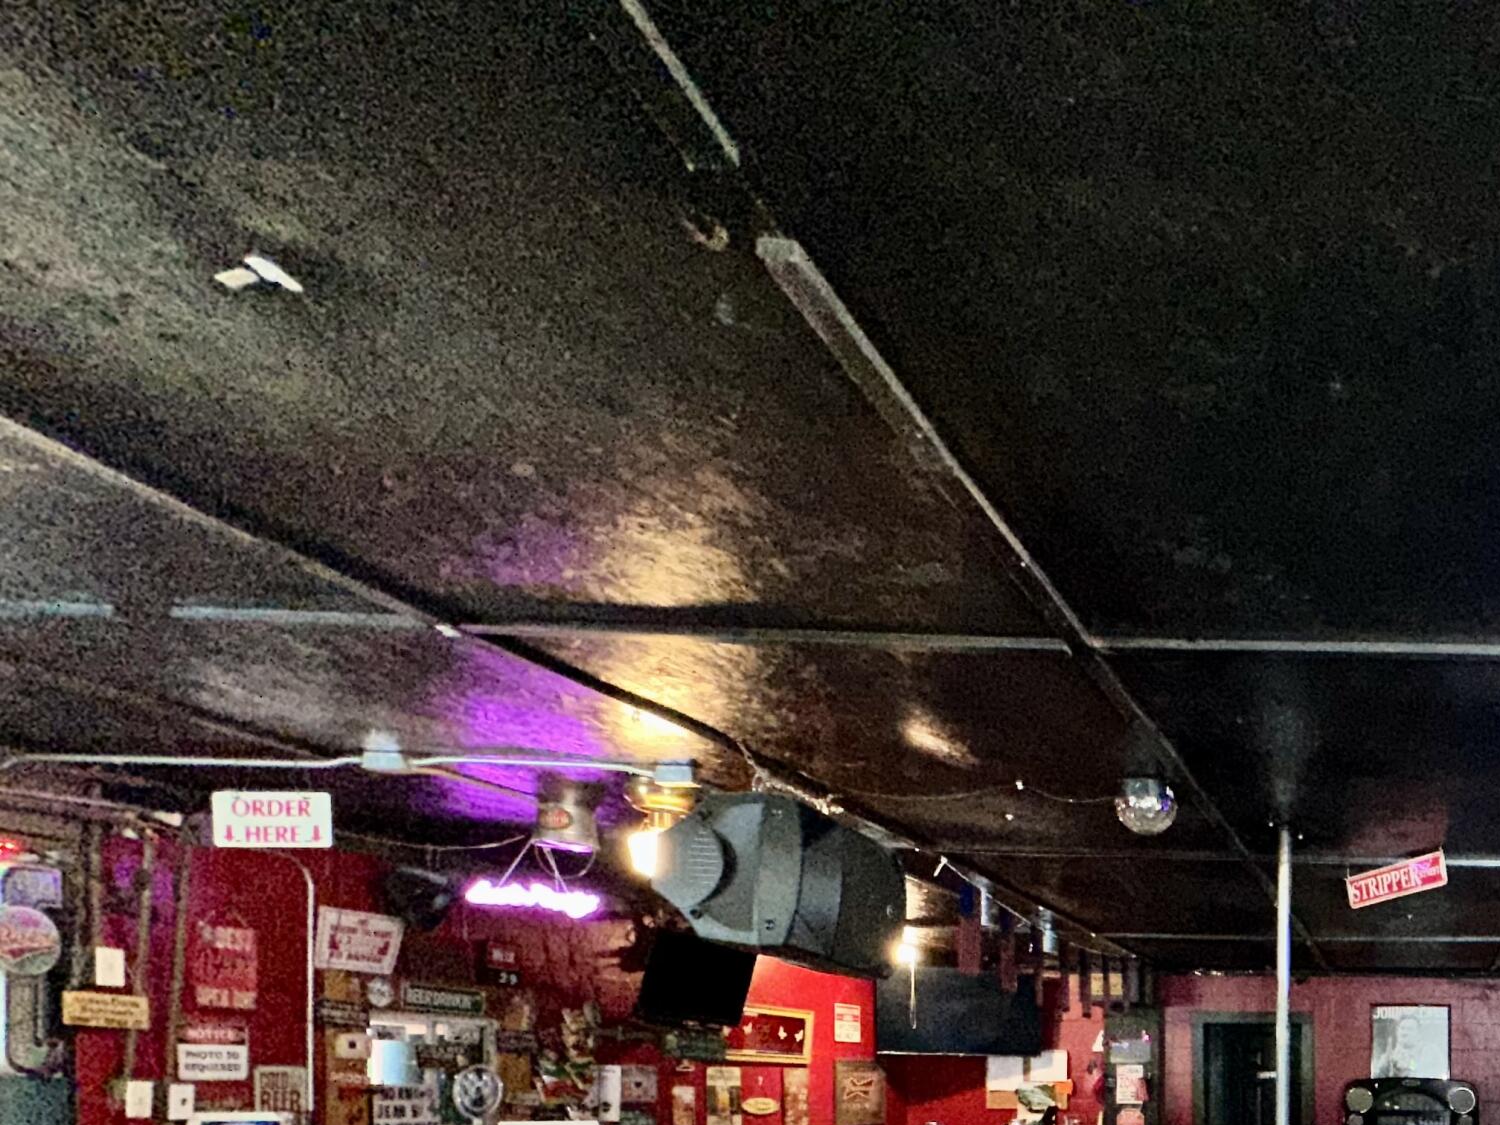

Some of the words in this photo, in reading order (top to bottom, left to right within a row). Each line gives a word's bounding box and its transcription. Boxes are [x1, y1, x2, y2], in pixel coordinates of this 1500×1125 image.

[231, 799, 311, 817] ORDER
[244, 825, 301, 842] HERE
[1351, 864, 1422, 902] STRIPPER
[185, 1050, 223, 1060] PHOTO
